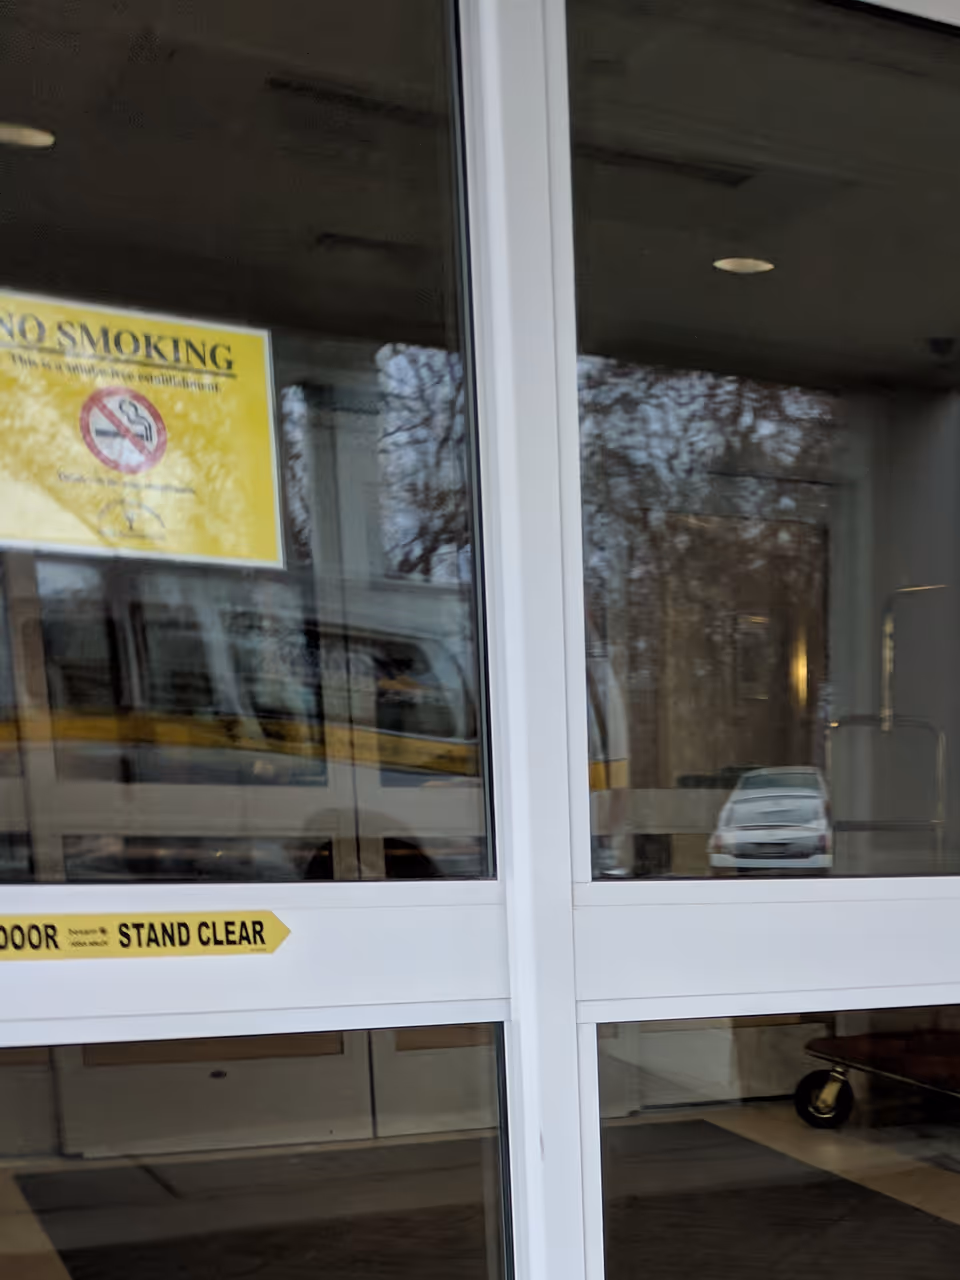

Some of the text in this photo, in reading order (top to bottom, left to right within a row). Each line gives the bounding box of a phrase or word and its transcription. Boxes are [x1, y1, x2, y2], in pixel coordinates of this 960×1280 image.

[0, 312, 234, 371] NO SMOKING
[118, 920, 266, 948] STAND CLEAR
